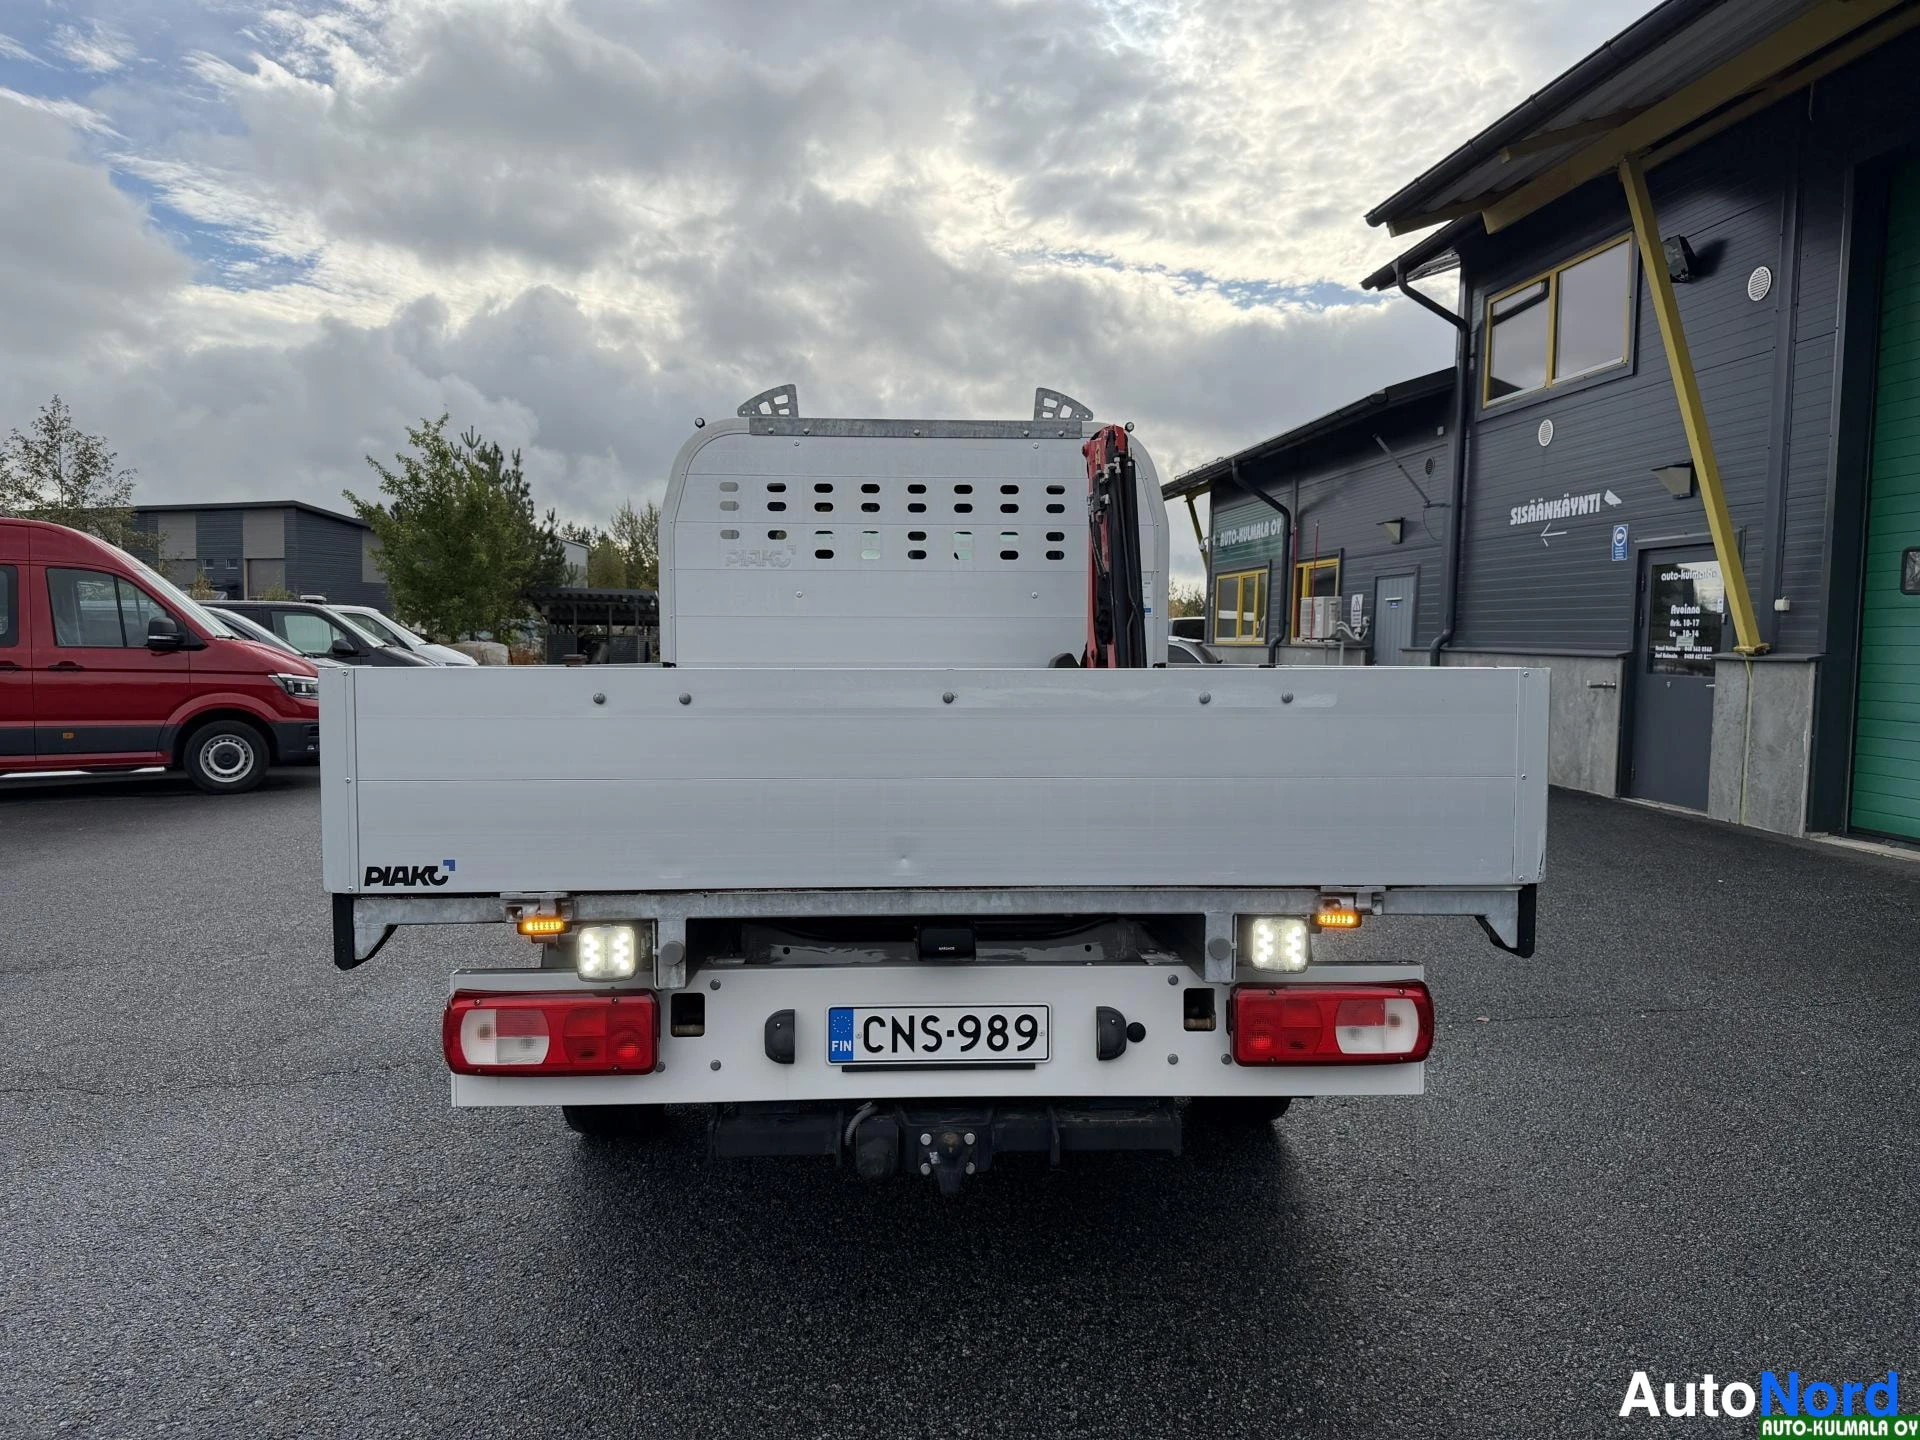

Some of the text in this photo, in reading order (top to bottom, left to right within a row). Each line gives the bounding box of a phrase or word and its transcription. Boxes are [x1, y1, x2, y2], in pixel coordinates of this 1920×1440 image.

[1509, 493, 1600, 525] SISÄÄNKÄYNTI
[1220, 520, 1269, 547] AUTO-KULMALA
[1670, 603, 1700, 614] Avoinna
[1683, 619, 1700, 627] 10-17
[364, 859, 456, 887] PIAKO
[831, 1014, 1038, 1053] FIN CNS-989
